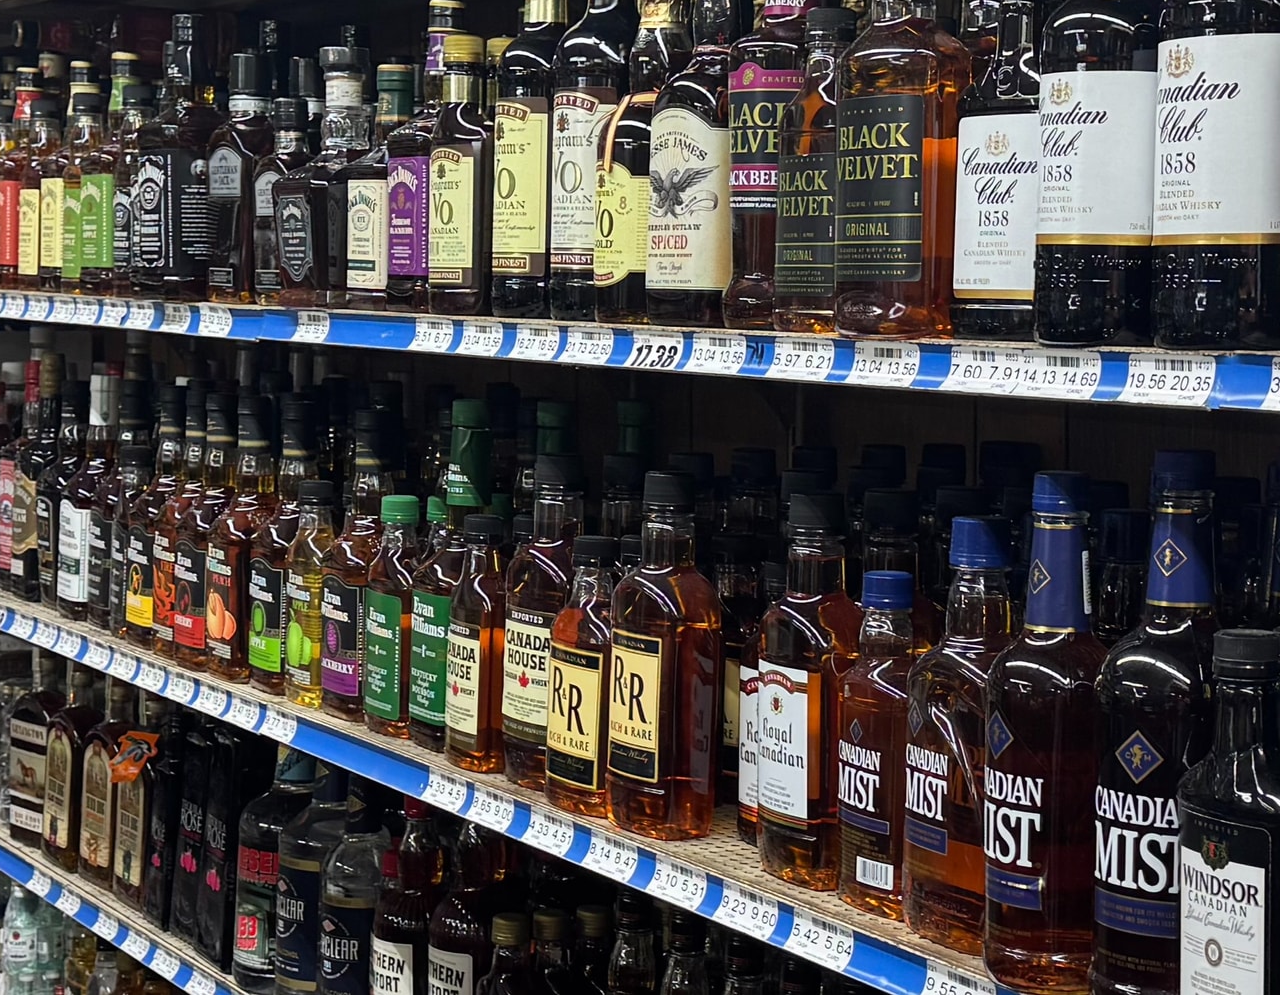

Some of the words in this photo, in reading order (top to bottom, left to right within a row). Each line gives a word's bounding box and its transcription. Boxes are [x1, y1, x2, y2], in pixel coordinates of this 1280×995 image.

[671, 134, 707, 161] JAMES
[839, 122, 911, 151] BLACK
[962, 147, 1038, 177] Canadian
[1160, 151, 1196, 175] 1858
[845, 222, 890, 237] ORIGINAL
[978, 210, 1009, 227] 1858
[651, 234, 688, 251] SPICED
[632, 344, 676, 368] 17.38
[1129, 373, 1166, 390] 19.56
[1170, 375, 1211, 392] 20.35
[511, 611, 544, 624] IMPORTED
[505, 624, 551, 653] CANADA
[507, 648, 546, 672] HOUSE
[762, 721, 793, 745] Royal
[838, 738, 881, 771] CANADIAN
[905, 742, 948, 776] CANADIAN
[838, 768, 879, 811] MIST
[905, 777, 948, 821] MIST
[654, 869, 678, 888] 5.10
[681, 879, 705, 897] 5.31
[1183, 862, 1259, 906] WINDSOR
[721, 896, 746, 915] 9.23
[750, 906, 777, 926] 9.60
[1187, 889, 1247, 918] CANADIAN
[792, 920, 819, 943] 5.42
[824, 932, 852, 955] 5.64
